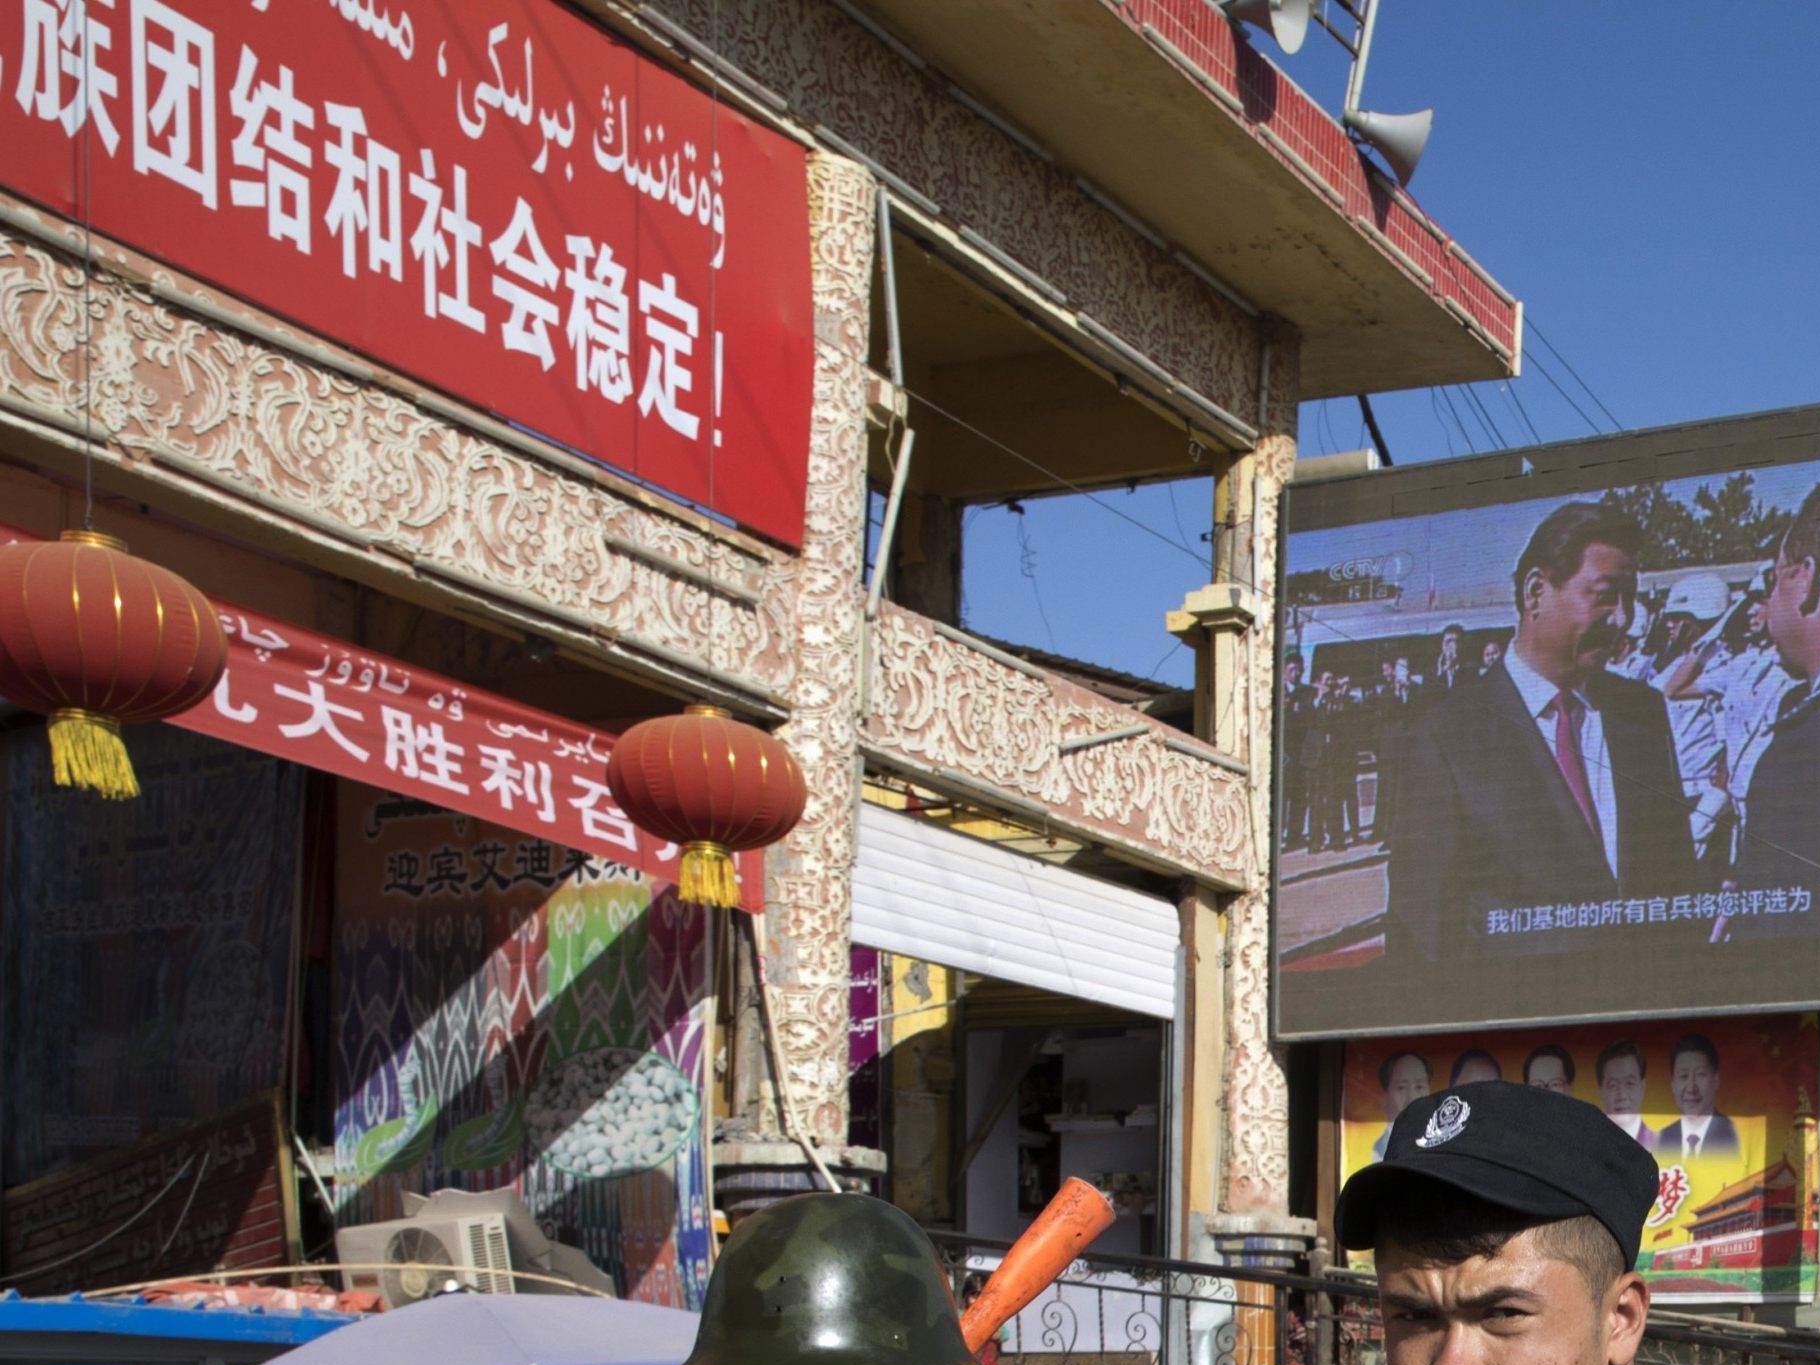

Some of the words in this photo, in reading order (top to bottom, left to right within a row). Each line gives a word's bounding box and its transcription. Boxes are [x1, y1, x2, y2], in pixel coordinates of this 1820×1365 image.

[1329, 555, 1385, 582] CCTV
[213, 668, 744, 884] 大胜利召！
[1487, 886, 1812, 935] 我们基地的所有官兵将您评选为
[1643, 1168, 1688, 1224] 梦
